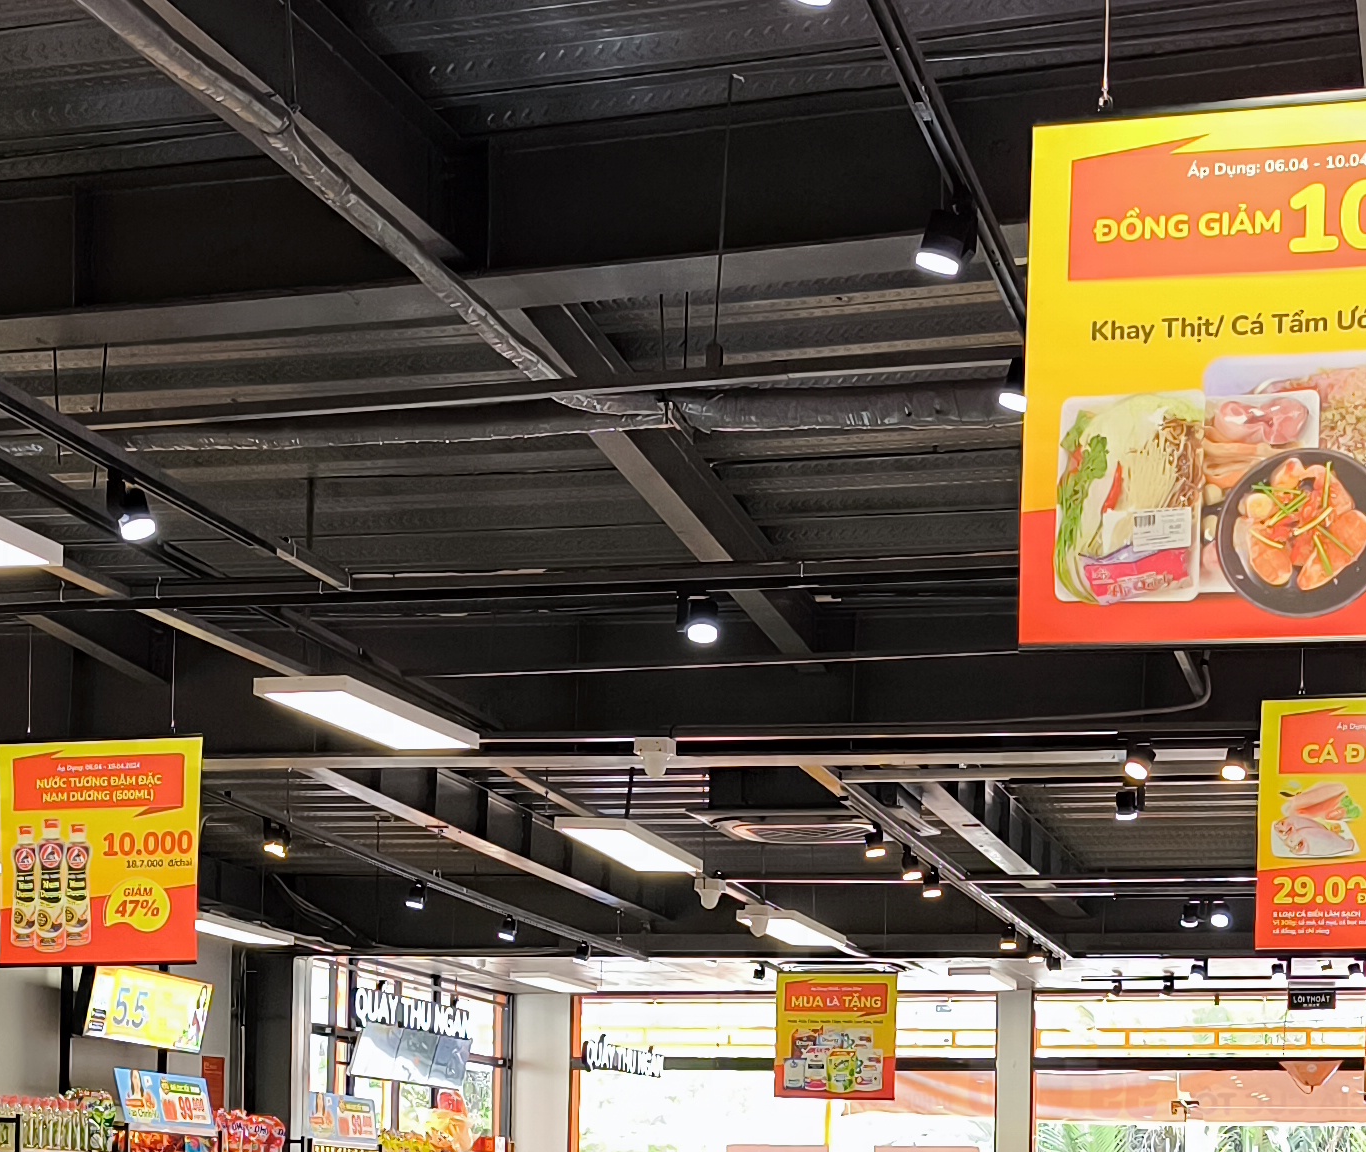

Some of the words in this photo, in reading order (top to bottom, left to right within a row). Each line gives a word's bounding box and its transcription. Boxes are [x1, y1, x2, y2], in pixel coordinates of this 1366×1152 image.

[1187, 161, 1210, 178] Áp
[1214, 160, 1261, 177] Dụng:
[1265, 157, 1309, 173] 06.04
[1093, 207, 1189, 243] ĐỒNG
[1198, 204, 1282, 239] GIẢM
[1091, 319, 1154, 345] Khay
[1162, 314, 1224, 341] Thịt/
[1232, 313, 1264, 337] Cá
[1272, 307, 1329, 335] Tẩm
[1302, 738, 1338, 764] CÁ
[36, 776, 67, 789] NƯỚC
[69, 775, 108, 788] TƯƠNG
[42, 791, 67, 803] NAM
[69, 789, 110, 801] DƯƠNG
[102, 830, 193, 857] 10.000
[123, 886, 154, 897] GIẢM
[114, 899, 160, 918] 47%
[112, 987, 149, 1029] 5.5
[402, 994, 432, 1032] THU
[791, 995, 823, 1007] MUA
[843, 992, 882, 1011] TẶNG
